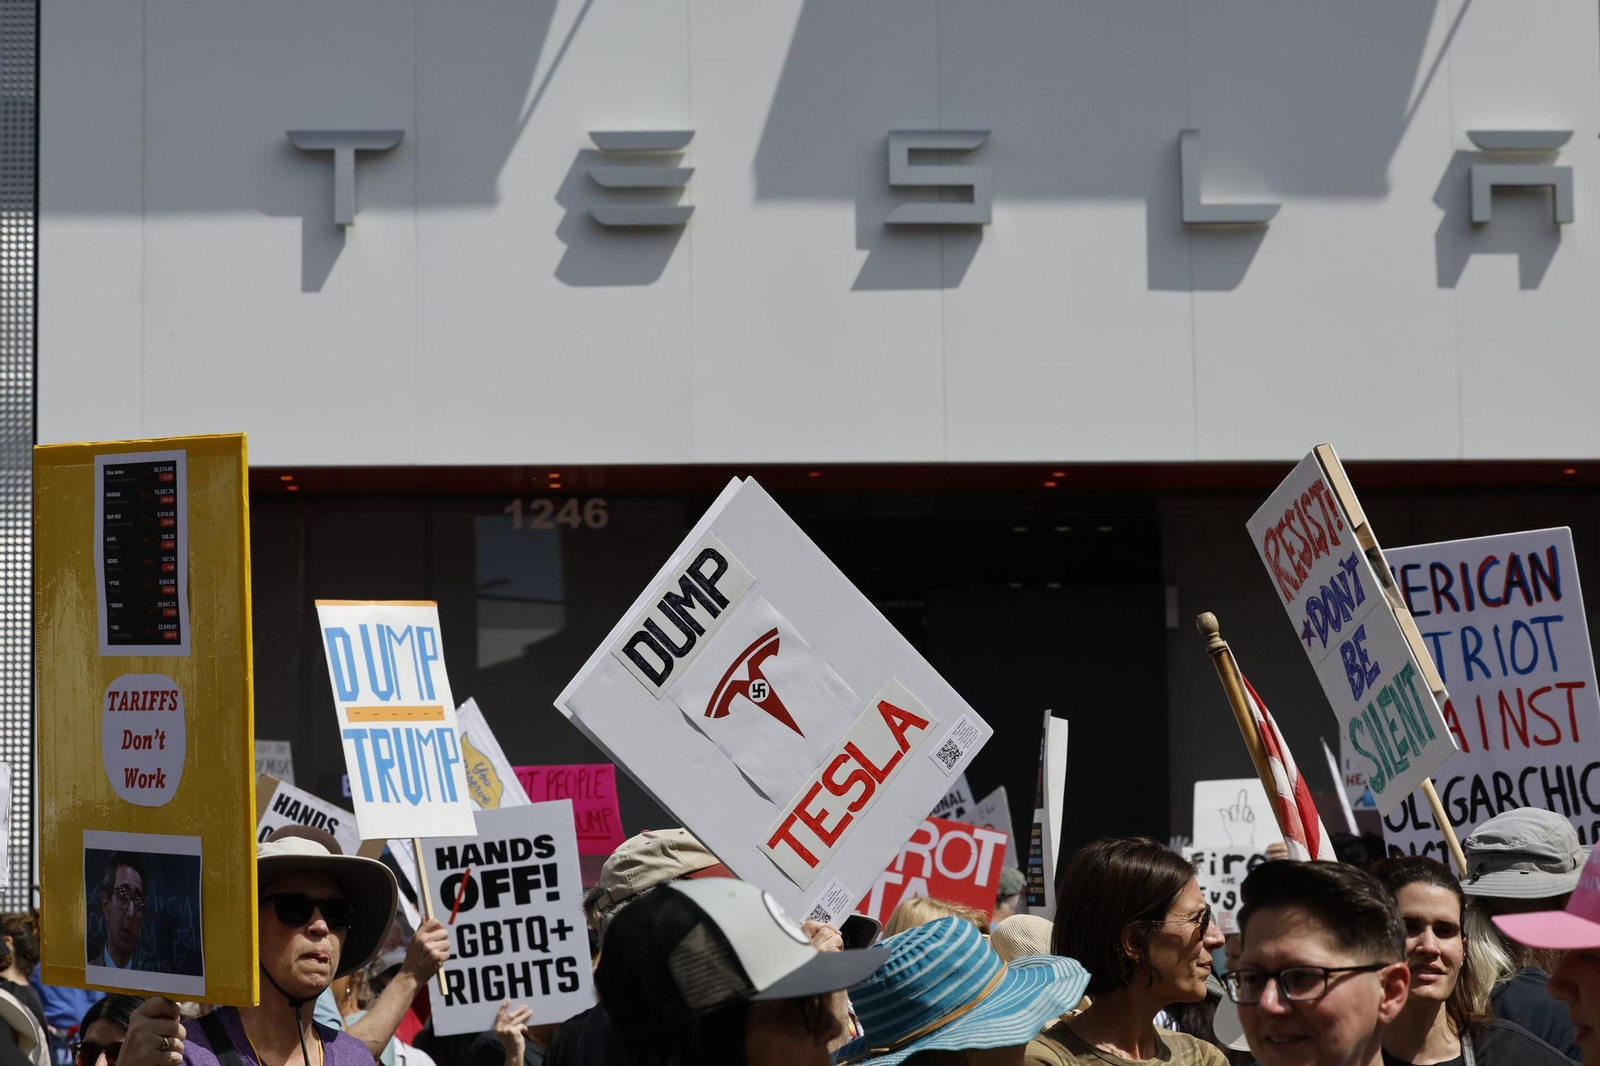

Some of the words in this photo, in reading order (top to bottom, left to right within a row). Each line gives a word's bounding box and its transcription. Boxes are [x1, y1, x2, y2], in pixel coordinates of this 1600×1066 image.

[285, 128, 1574, 227] TESLA
[504, 499, 609, 530] 1246
[1264, 478, 1343, 605] RESIST!
[1391, 545, 1563, 618] ERICAN
[621, 547, 730, 688] DUMP
[324, 623, 438, 702] DUMP
[1340, 623, 1381, 701] BE
[108, 690, 178, 711] TARIFFS
[1349, 660, 1437, 795] SILENT
[124, 768, 166, 788] Work
[342, 727, 459, 806] TRUMP
[547, 768, 605, 801] PEOPLE
[766, 699, 930, 869] TESLA
[1346, 774, 1366, 786] HE
[273, 793, 339, 836] HANDS
[1384, 762, 1600, 833] OLGARCHIC
[435, 834, 555, 871] HANDS
[440, 862, 560, 913] OFF!
[447, 915, 573, 959] GBTQ+
[445, 956, 579, 1006] RIGHTS
